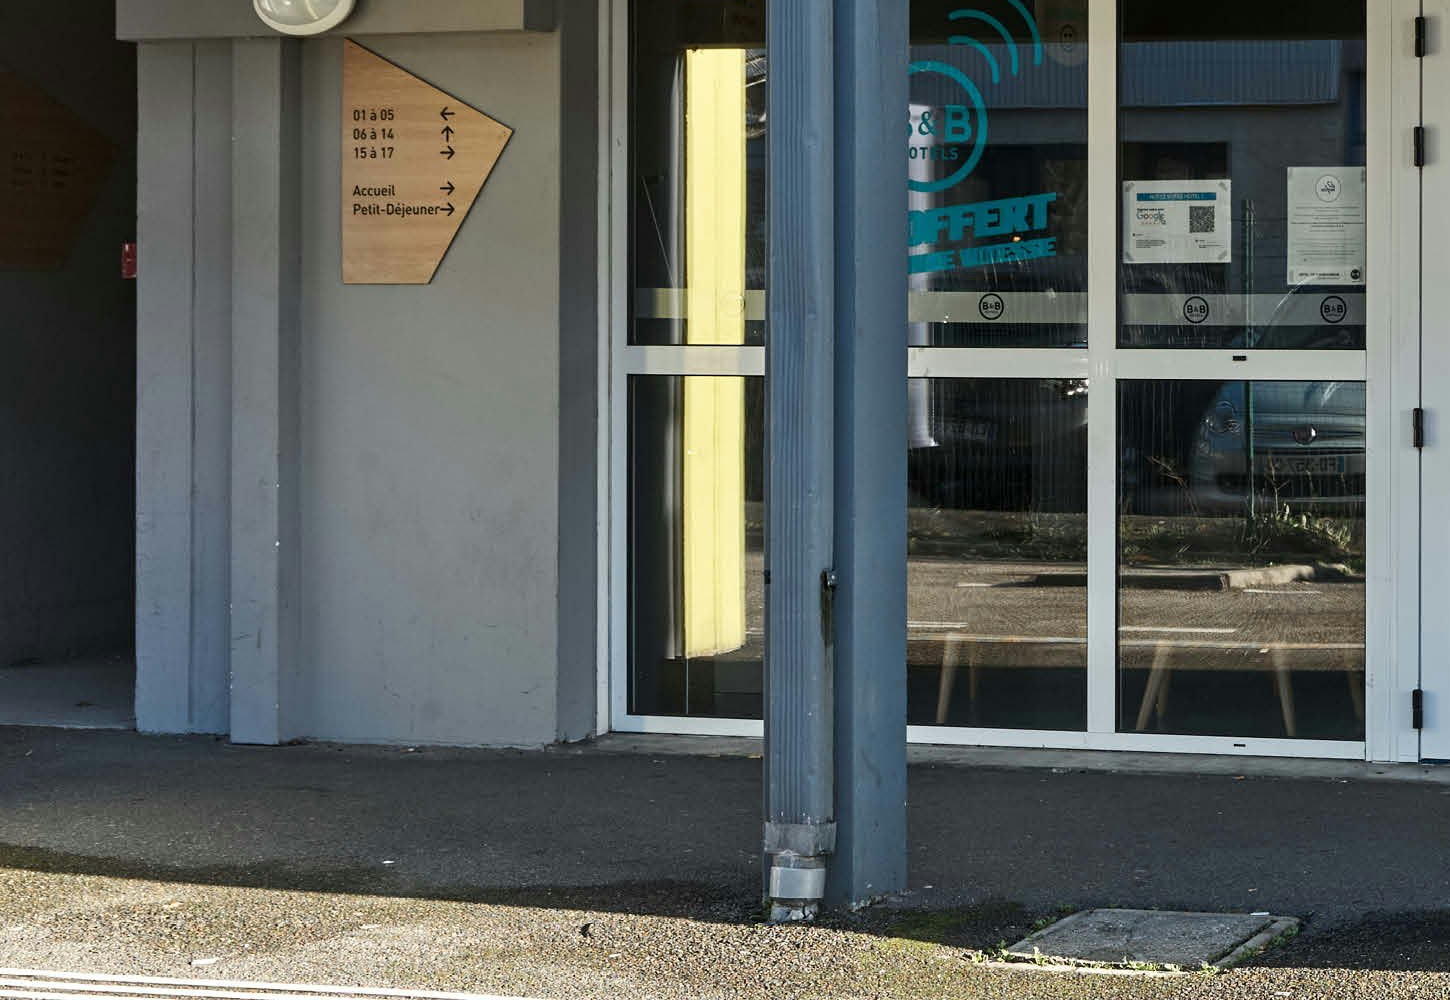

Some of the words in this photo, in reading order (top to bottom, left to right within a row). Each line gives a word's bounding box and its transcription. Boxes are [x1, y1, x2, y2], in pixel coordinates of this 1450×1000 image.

[353, 109, 366, 121] 01
[380, 109, 394, 121] 05
[908, 105, 972, 143] &B
[353, 128, 367, 140] 06
[381, 128, 394, 140] 14
[354, 147, 367, 159] 15
[381, 147, 394, 159] 17
[908, 146, 959, 161] OTELS
[352, 185, 395, 196] Accueil
[353, 203, 440, 218] Petit-Déjeuner
